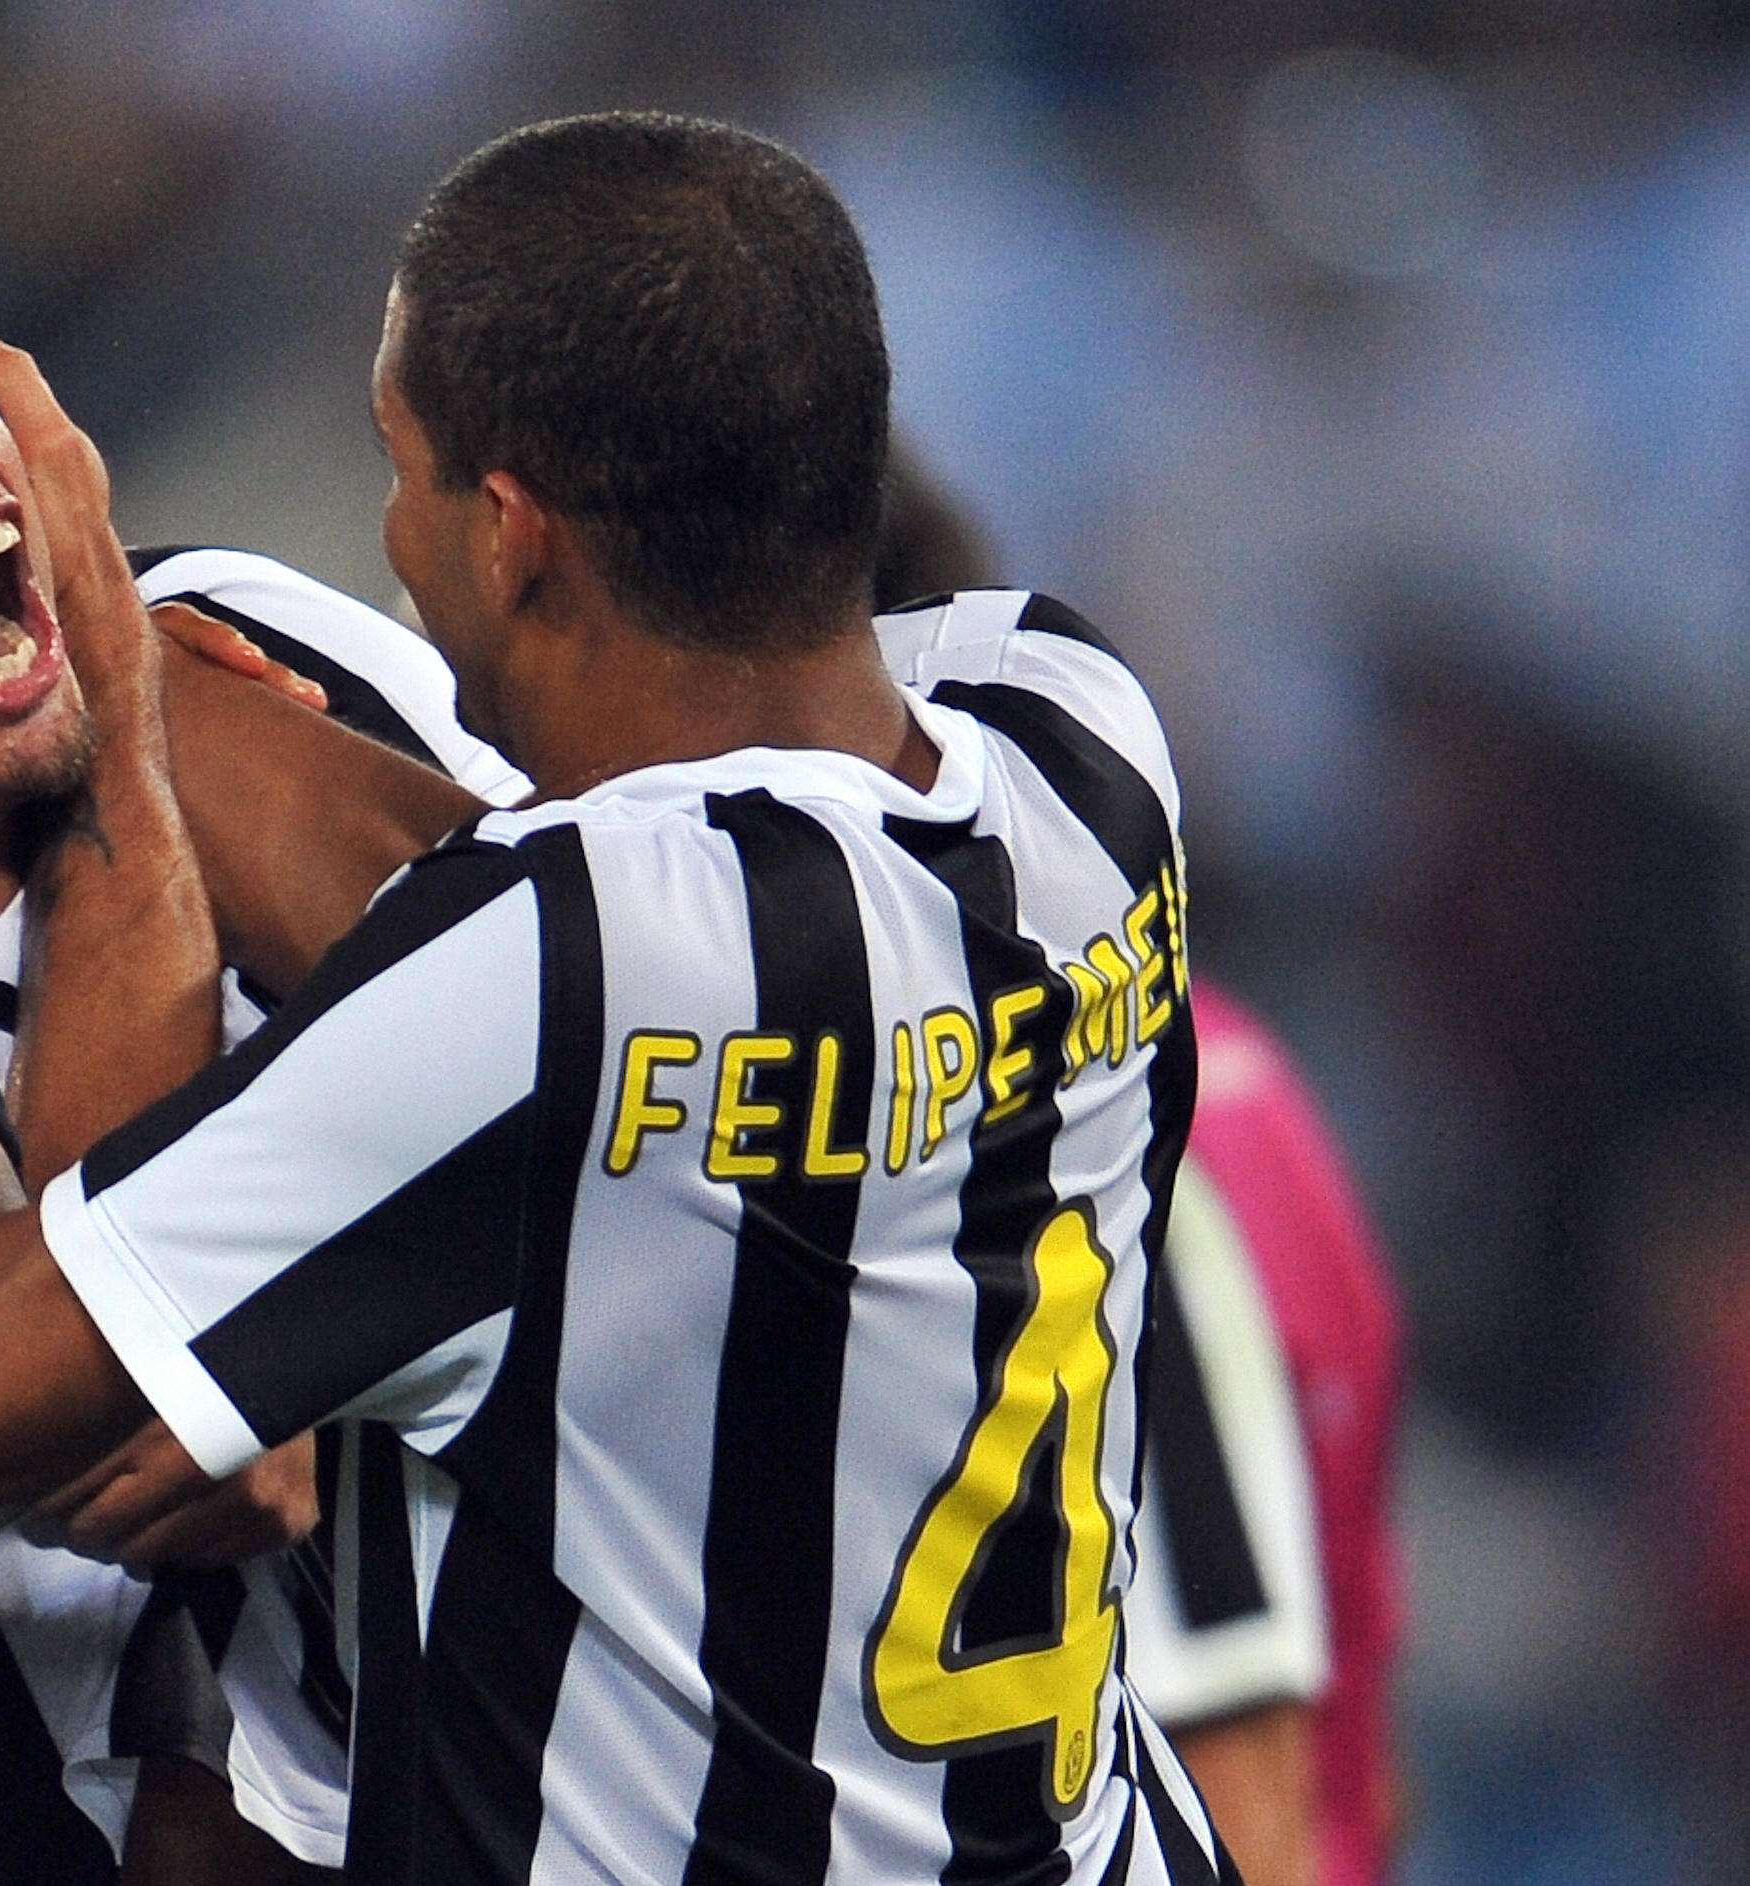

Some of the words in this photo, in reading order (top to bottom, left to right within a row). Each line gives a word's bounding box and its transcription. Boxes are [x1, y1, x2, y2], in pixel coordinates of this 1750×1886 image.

[603, 983, 1047, 1179] FELIPE
[1058, 858, 1188, 1092] MEL
[866, 1198, 1116, 1818] 4
